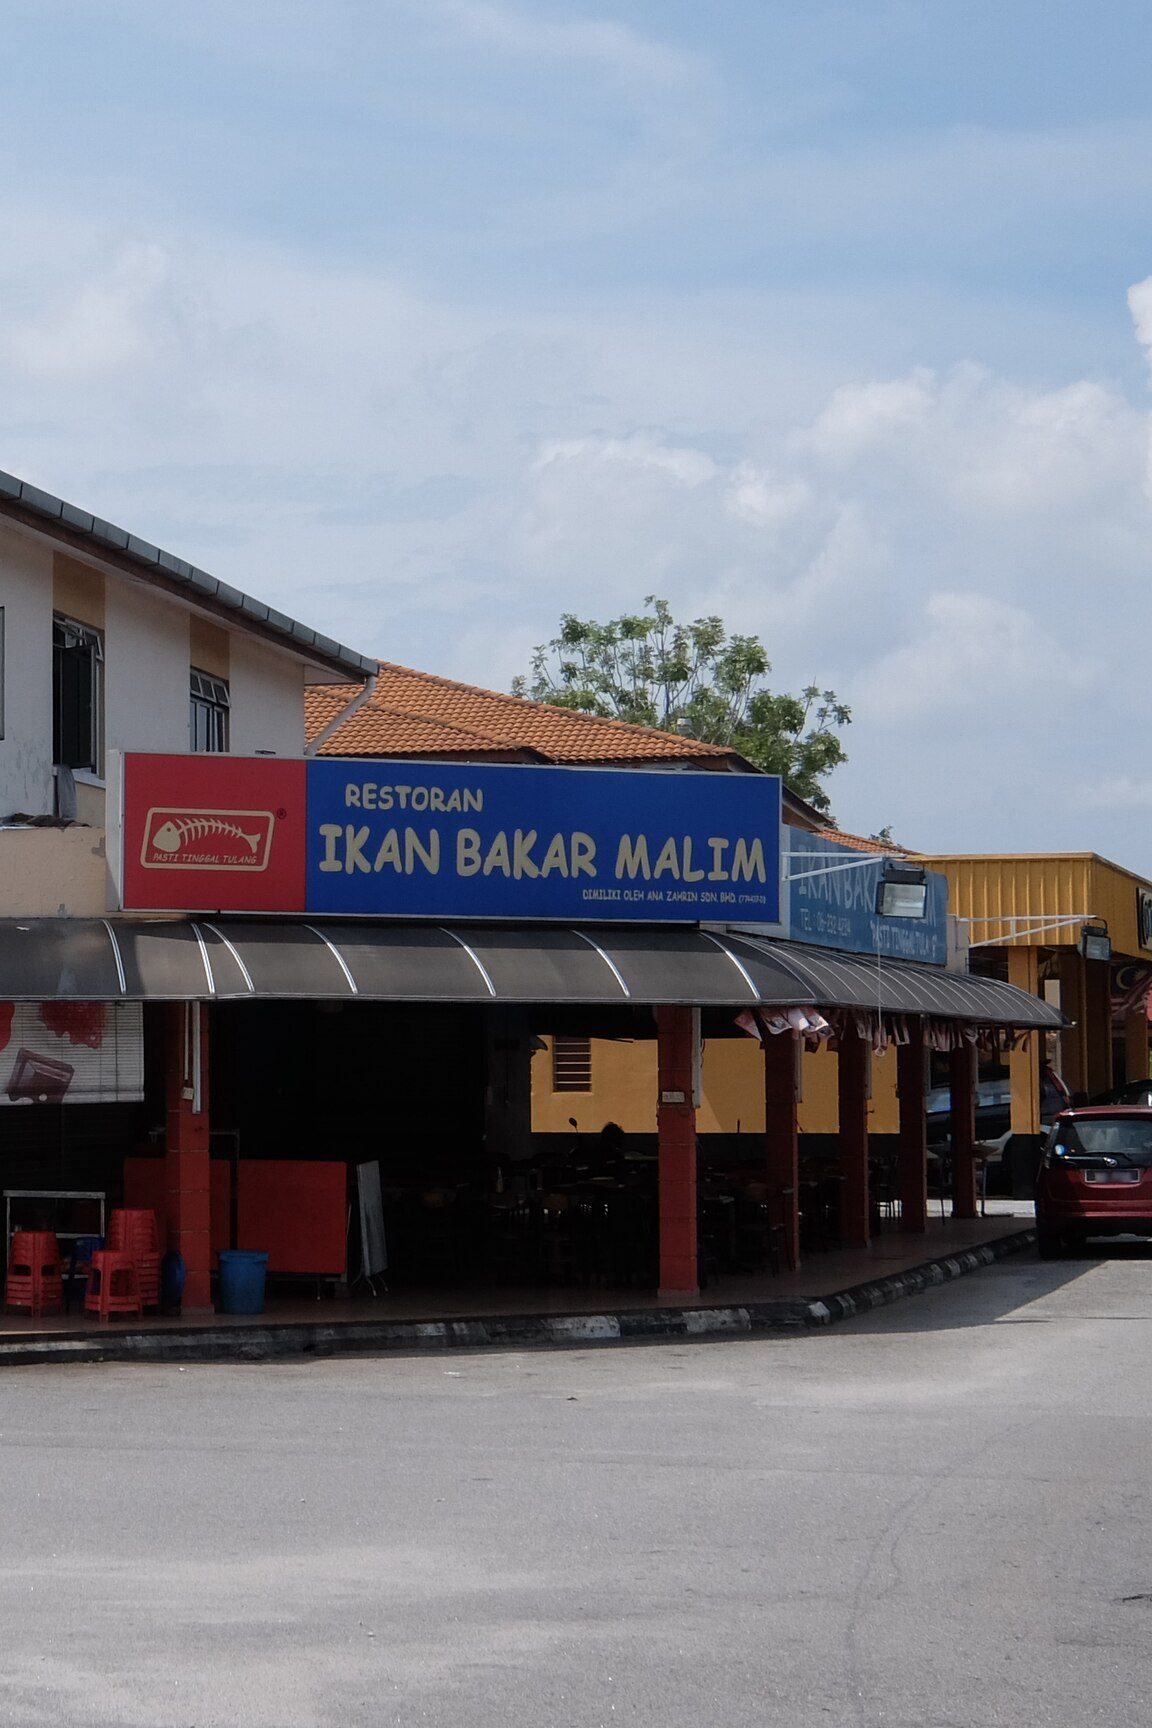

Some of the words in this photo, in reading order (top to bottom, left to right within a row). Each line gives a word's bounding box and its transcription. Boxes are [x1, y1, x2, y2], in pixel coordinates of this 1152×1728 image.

[345, 783, 483, 813] RESTORAN
[152, 852, 179, 863] PASTI
[181, 853, 220, 864] TINGGAL
[222, 854, 257, 866] TULANG
[319, 824, 441, 876] IKAN
[456, 828, 598, 881] BAKAR
[615, 834, 767, 884] MALIM
[582, 888, 621, 901] DIMILIKI
[623, 889, 645, 902] OLEH
[647, 890, 664, 902] ANA
[666, 890, 698, 903] ZAHRIN
